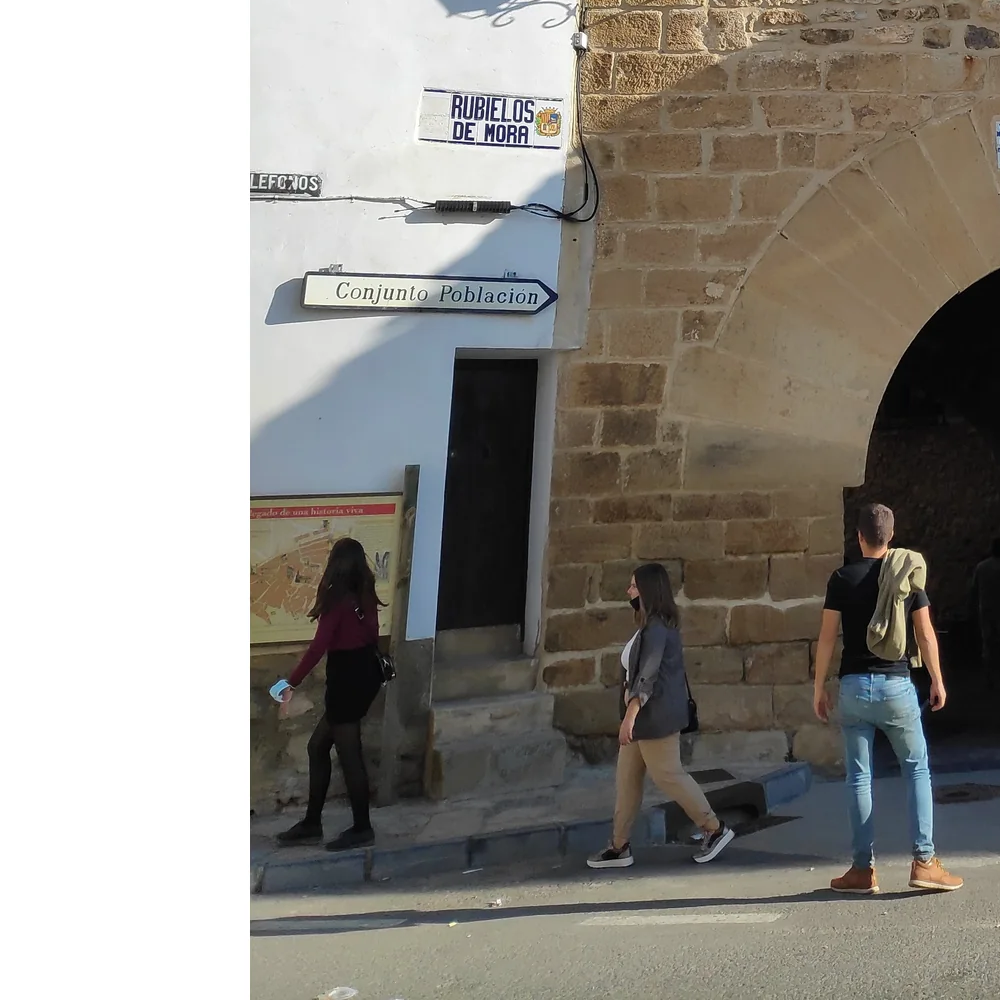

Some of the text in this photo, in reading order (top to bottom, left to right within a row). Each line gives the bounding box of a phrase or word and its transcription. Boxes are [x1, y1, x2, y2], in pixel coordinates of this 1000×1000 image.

[451, 94, 535, 123] RUBIELOS
[452, 121, 529, 144] DE MORA
[335, 281, 539, 305] Conjunto Población
[279, 508, 290, 516] de
[310, 507, 344, 516] historia
